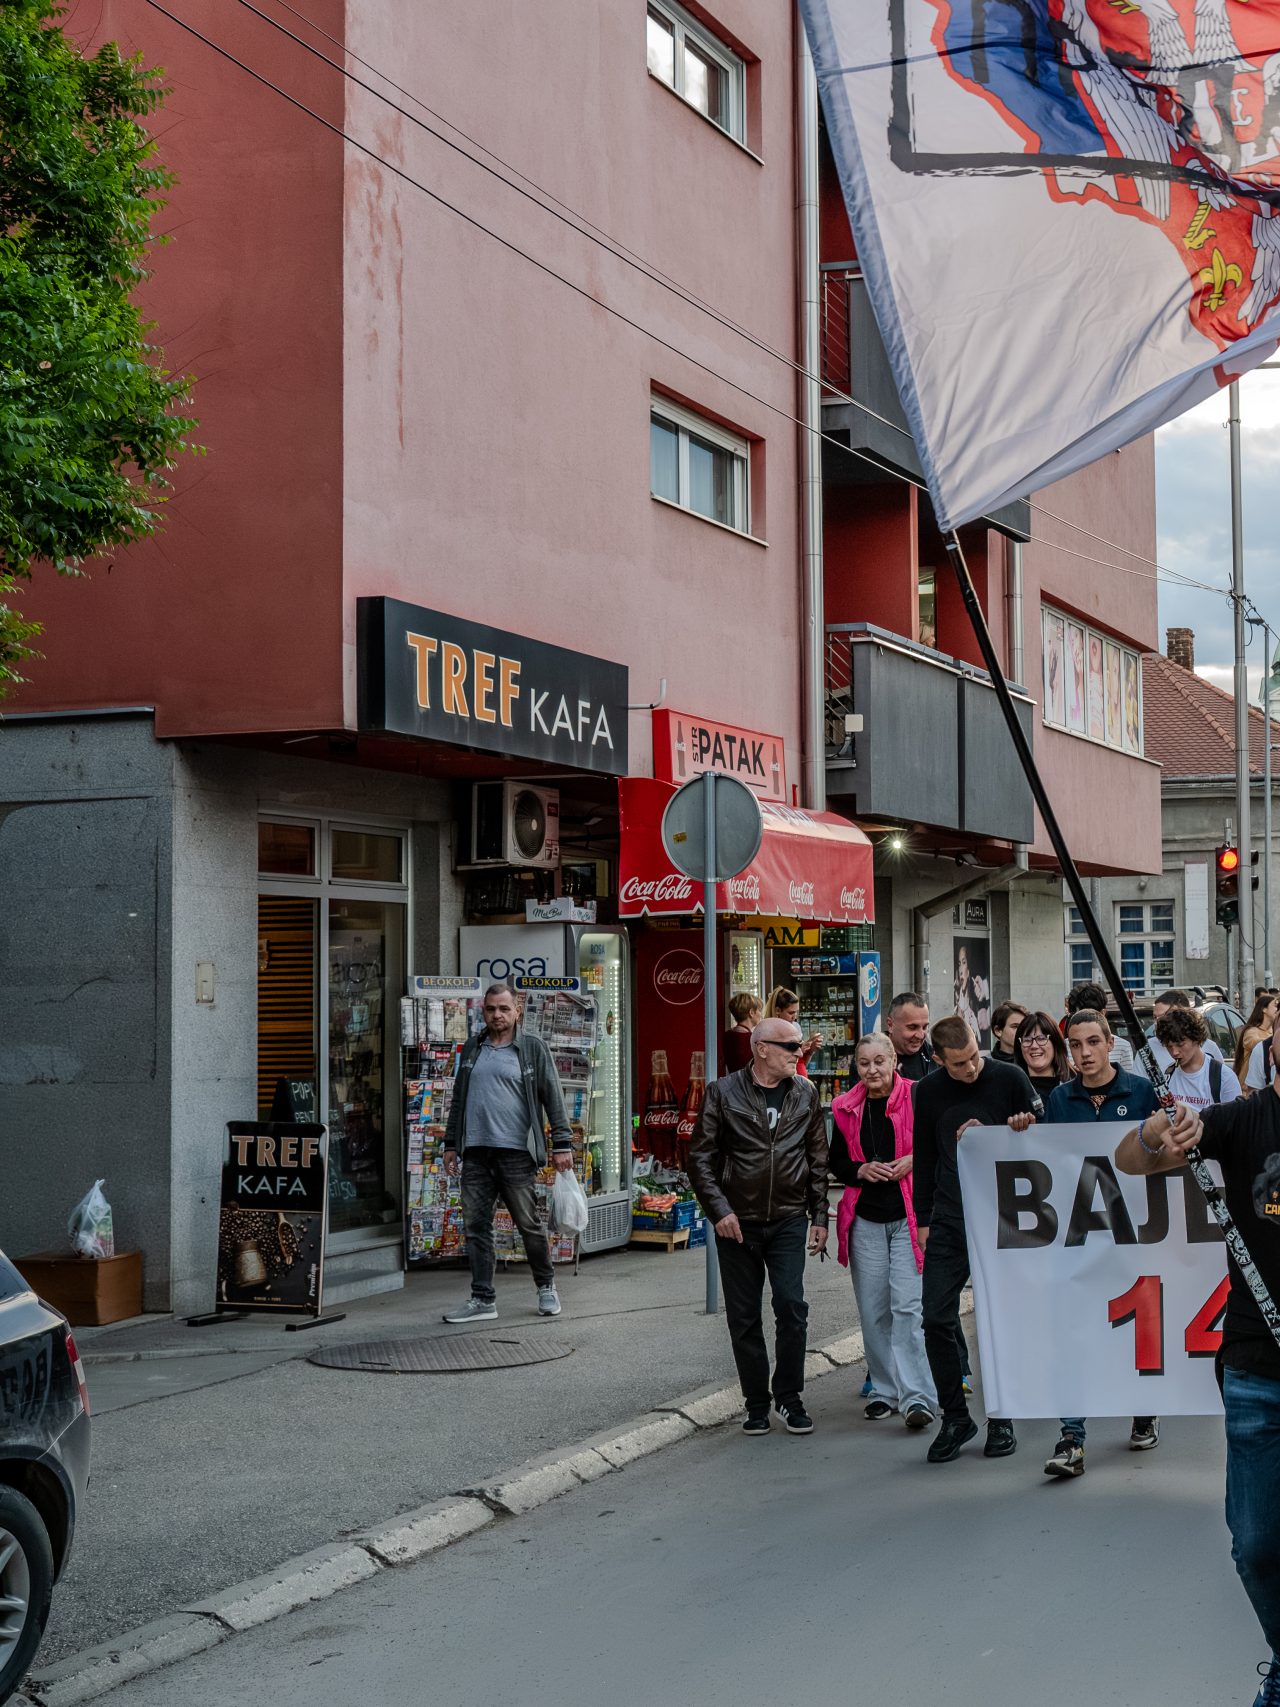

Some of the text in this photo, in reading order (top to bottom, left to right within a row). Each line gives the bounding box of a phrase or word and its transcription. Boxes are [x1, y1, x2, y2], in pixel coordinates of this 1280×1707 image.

[406, 631, 614, 750] TREF KAFA
[698, 727, 766, 777] PATAK
[477, 957, 547, 980] rosa
[422, 977, 475, 987] BEOKOLP
[521, 977, 574, 987] BEOKOLP
[231, 1135, 319, 1168] TREF
[237, 1175, 307, 1196] KAFA
